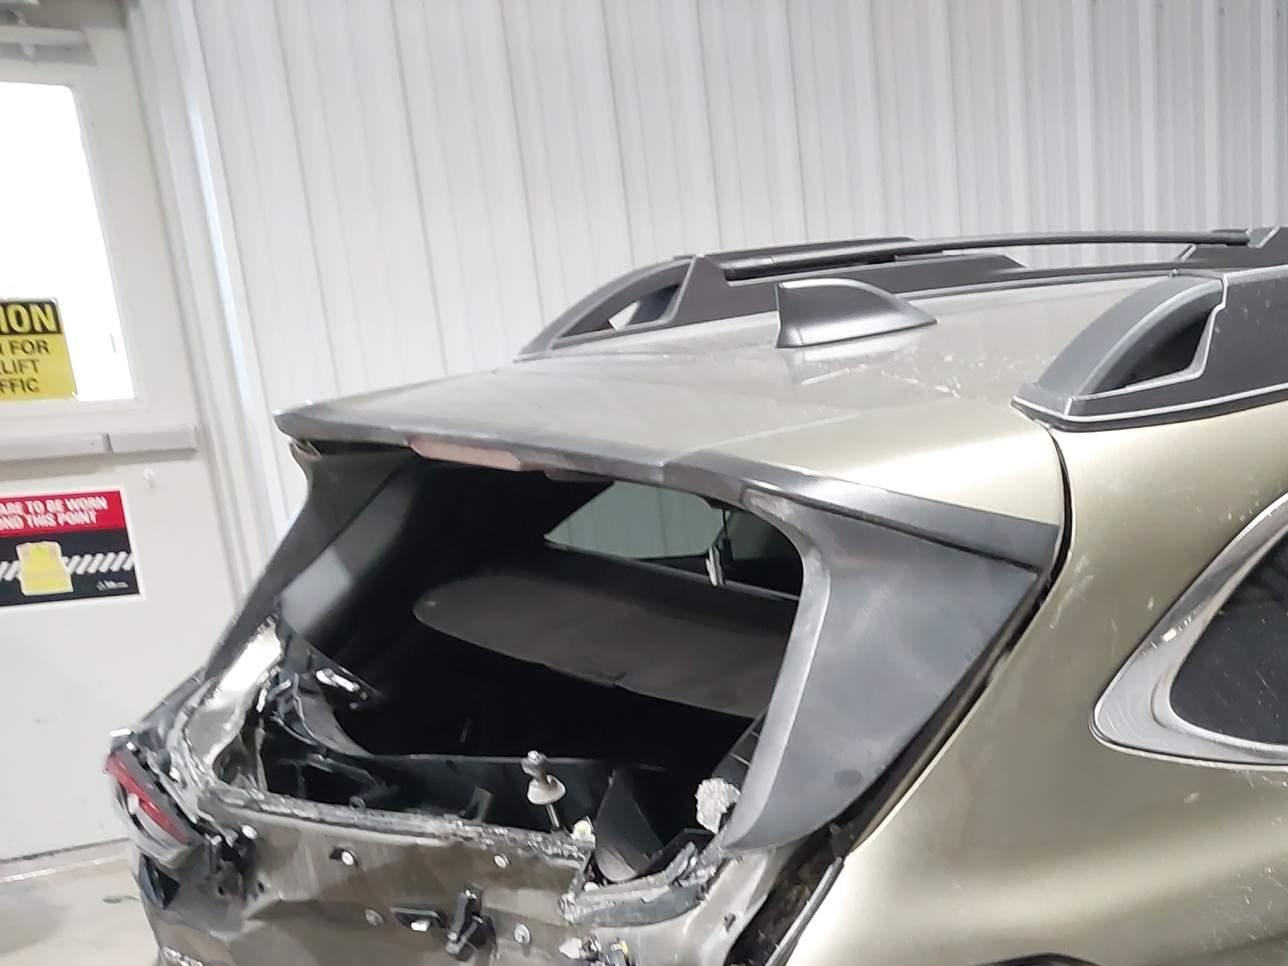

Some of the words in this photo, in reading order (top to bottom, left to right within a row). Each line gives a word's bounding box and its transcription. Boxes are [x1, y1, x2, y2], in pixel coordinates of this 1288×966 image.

[9, 339, 50, 355] FOR
[0, 359, 40, 375] LIFT
[24, 500, 45, 515] TO
[65, 496, 108, 511] WORN
[24, 513, 57, 528] THIS
[57, 510, 97, 526] POINT
